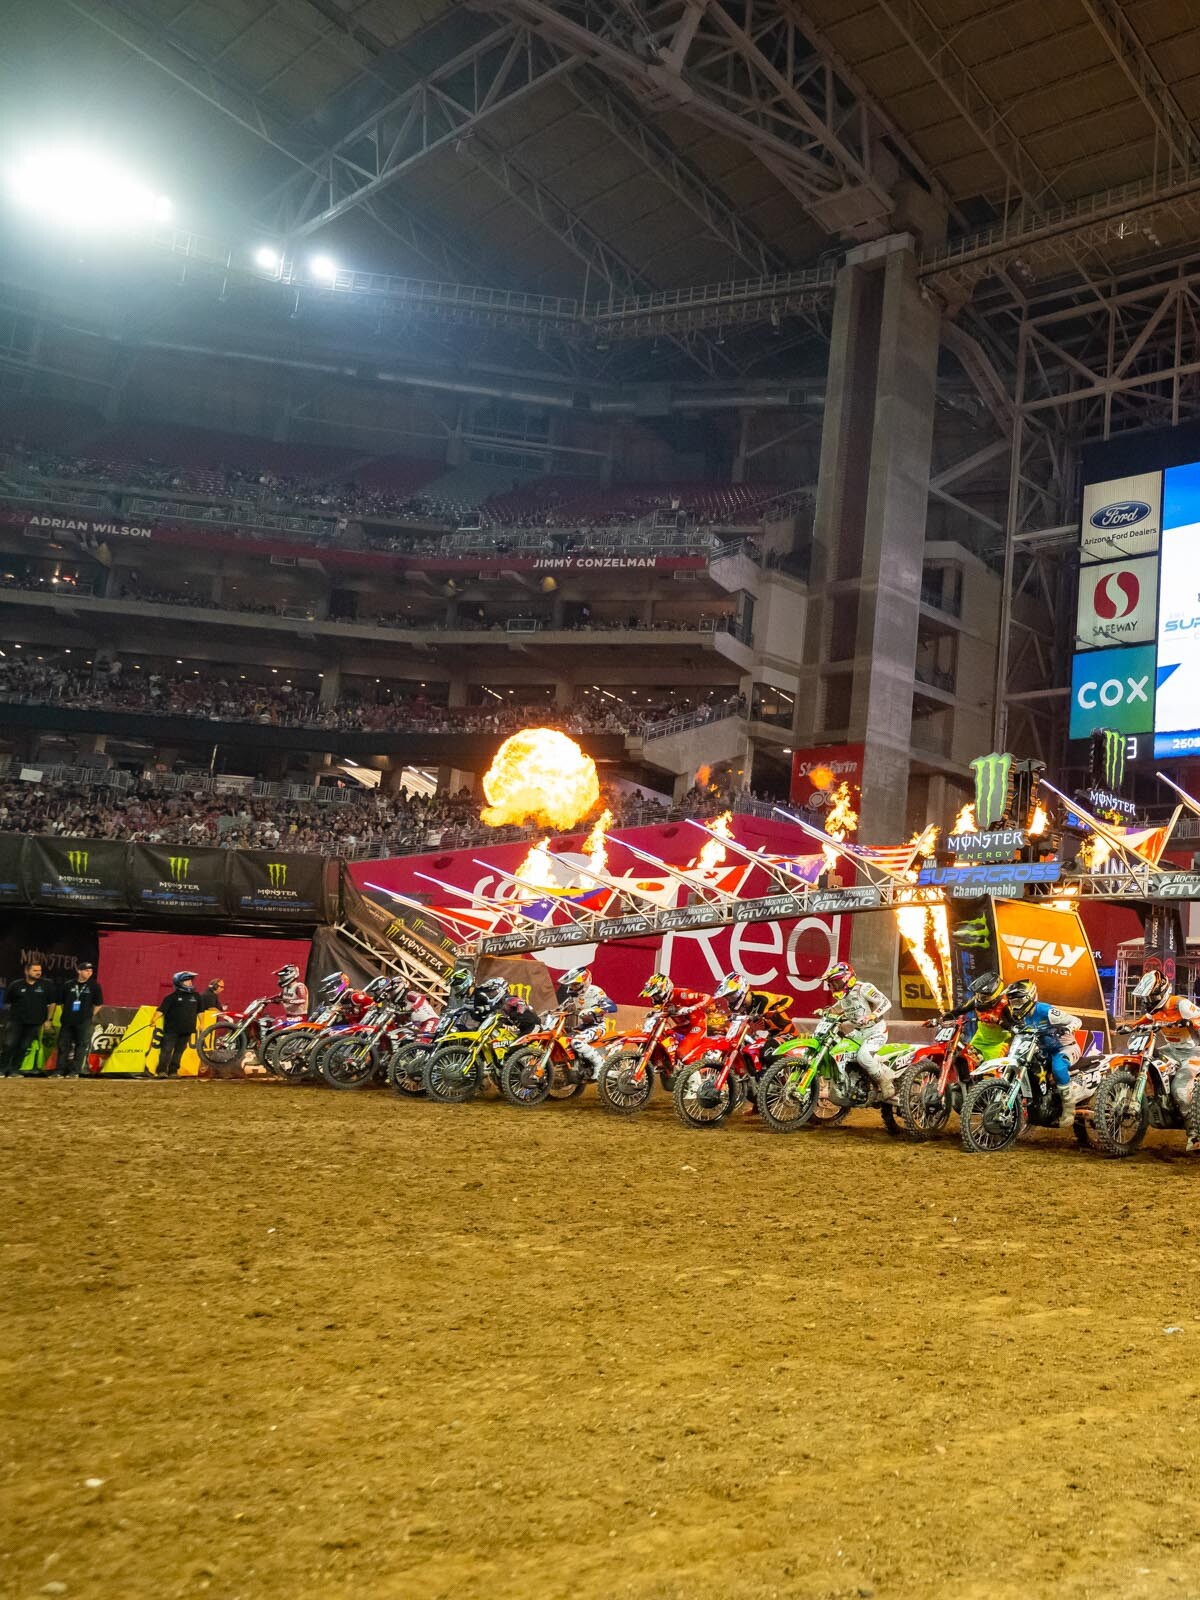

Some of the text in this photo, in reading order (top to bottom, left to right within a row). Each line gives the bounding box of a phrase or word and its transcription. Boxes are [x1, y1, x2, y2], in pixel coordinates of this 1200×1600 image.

[1101, 503, 1139, 526] Ford
[30, 516, 152, 538] ADRIAN WILSON
[1083, 526, 1158, 546] Arizona Ford Dealers
[533, 557, 656, 569] JIMMY CONZELMAN
[1092, 621, 1139, 637] SAFEWAY
[1077, 676, 1149, 710] COX
[1090, 790, 1137, 816] MONSTER
[948, 831, 1025, 851] MONSTER
[959, 850, 1013, 860] ENERGY
[922, 859, 937, 869] AMA
[918, 863, 1063, 886] SUPERCROSS
[159, 881, 200, 891] MONSTER
[257, 888, 298, 897] MONSTER
[953, 883, 1017, 898] Championship
[822, 889, 877, 901] ROCKY MOUNTAIN
[745, 901, 763, 910] ROCKY
[399, 934, 444, 970] MONSTER
[1000, 933, 1087, 968] FLY
[1017, 963, 1069, 977] RACING
[1131, 1036, 1149, 1051] 41
